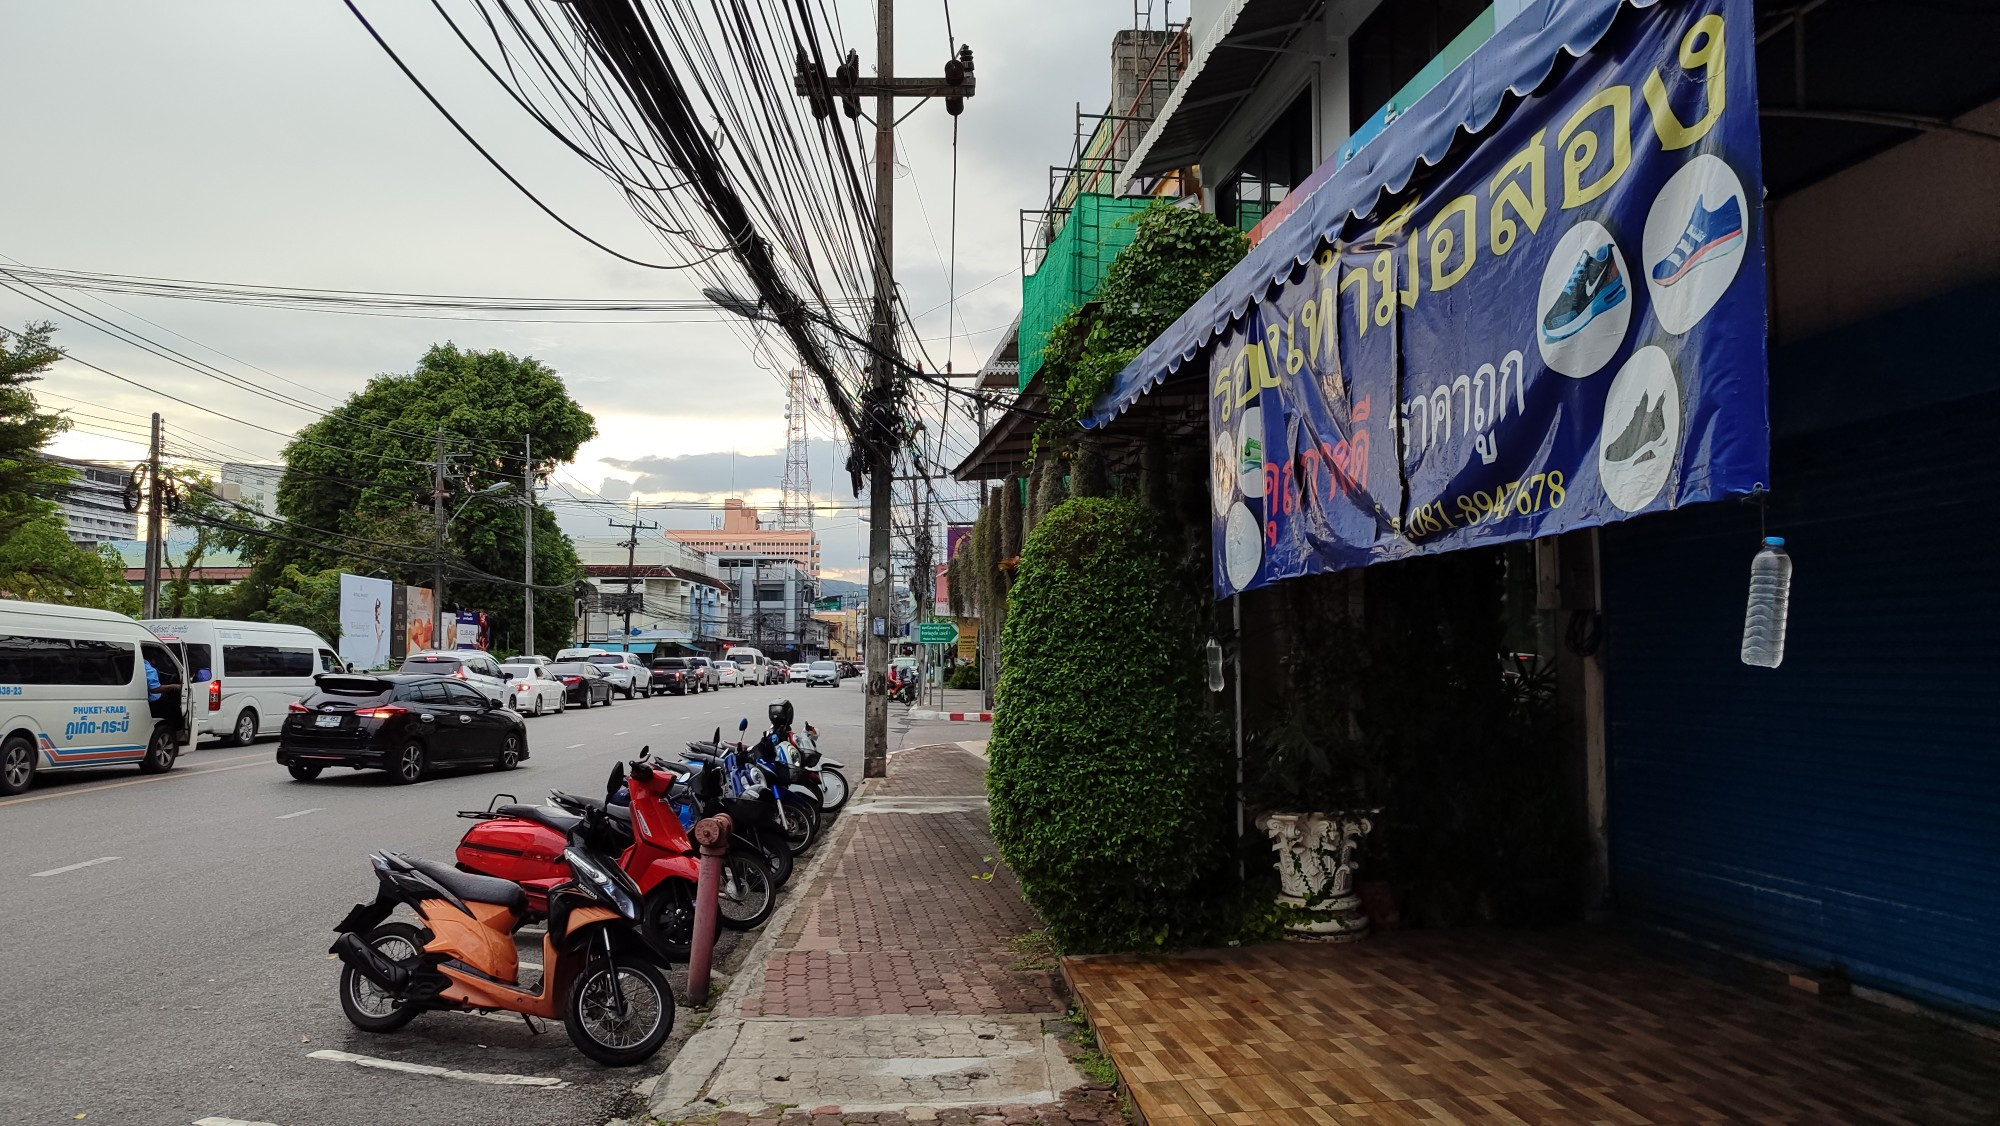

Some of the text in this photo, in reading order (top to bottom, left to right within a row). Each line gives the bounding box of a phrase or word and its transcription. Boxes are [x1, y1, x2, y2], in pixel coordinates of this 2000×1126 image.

[1388, 348, 1526, 465] ราคาถูก
[73, 706, 126, 714] PHUKET-KRABI
[65, 712, 130, 740] ภูเก็ต-กระบี่
[578, 882, 598, 900] HONDA
